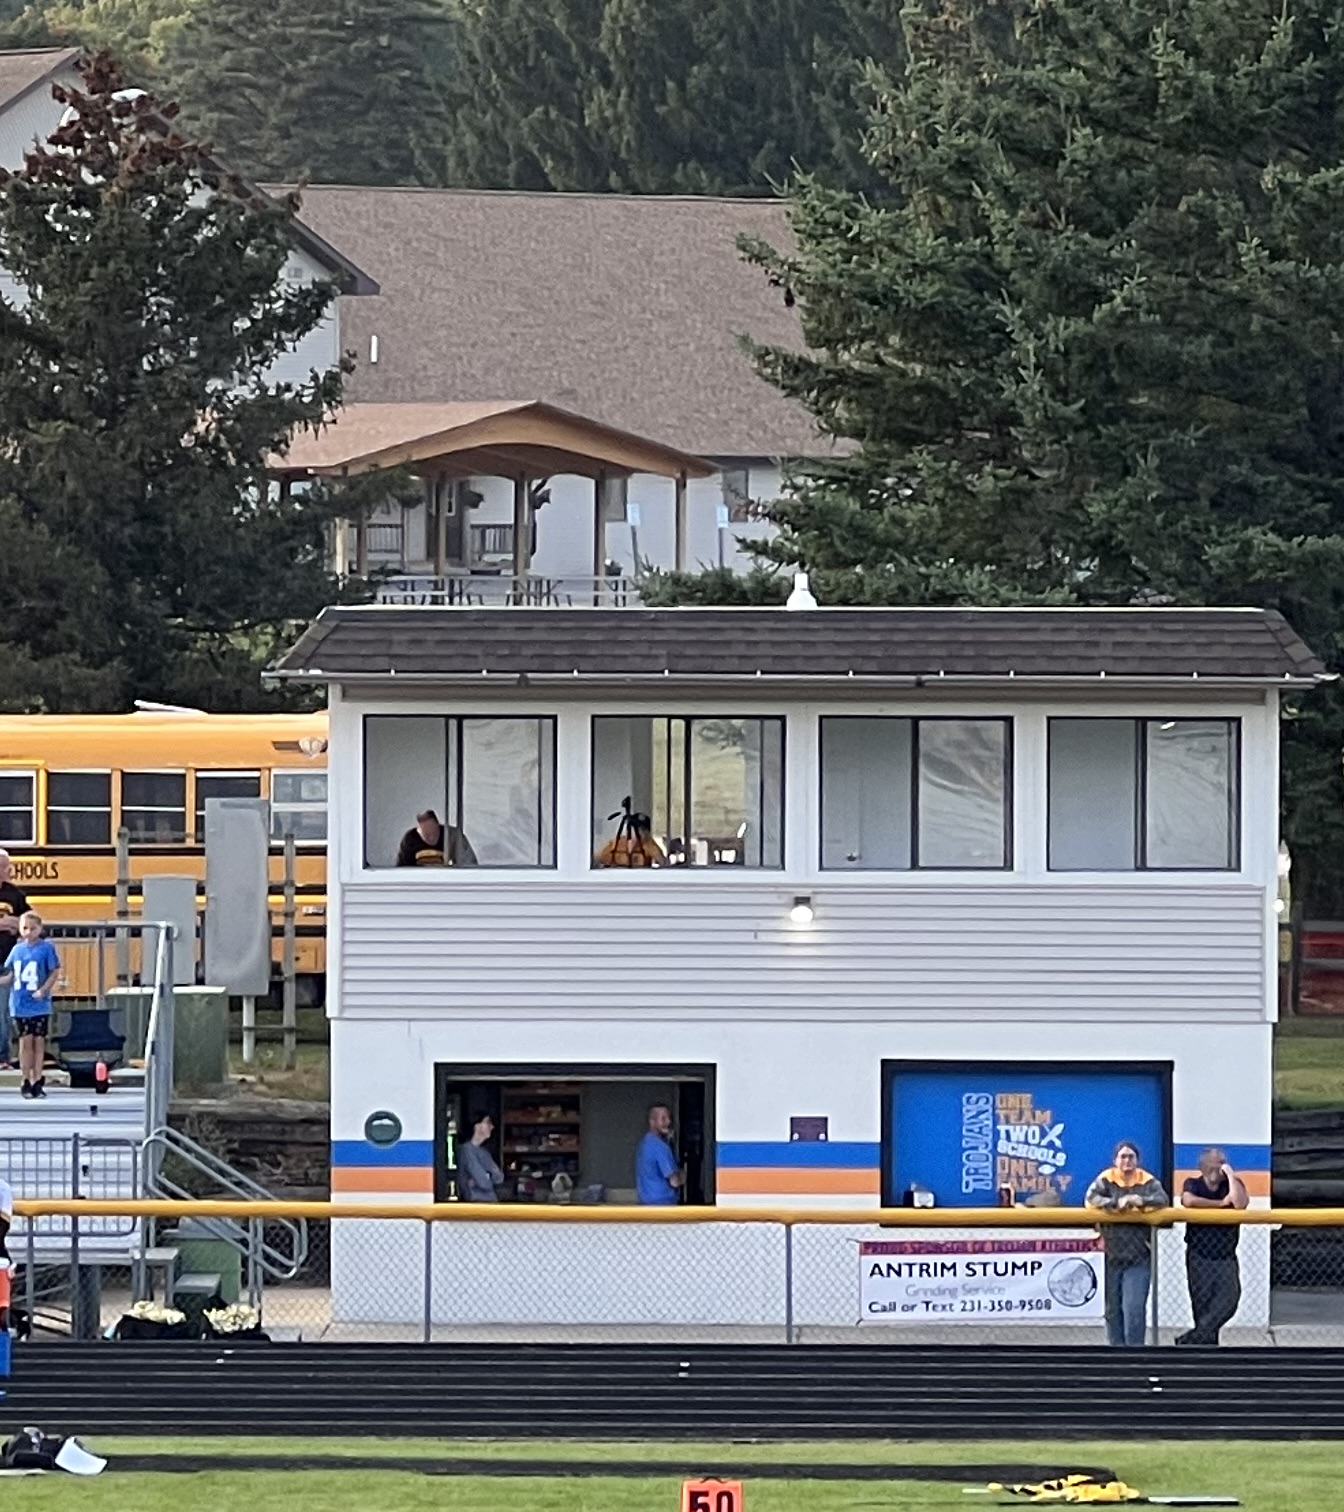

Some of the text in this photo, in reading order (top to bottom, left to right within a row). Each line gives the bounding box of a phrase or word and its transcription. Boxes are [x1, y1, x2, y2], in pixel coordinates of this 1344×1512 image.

[7, 861, 59, 880] CHOOLS
[13, 960, 39, 991] 14
[996, 1109, 1053, 1125] TEAM
[962, 1092, 993, 1194] TROJANS
[997, 1125, 1041, 1145] TWO
[997, 1139, 1067, 1167] SCHOOLS
[996, 1155, 1040, 1177] ONE
[869, 1260, 1043, 1278] ANTRIM STUMP
[905, 1283, 1006, 1300] Grinding Service
[868, 1301, 897, 1314] Call
[901, 1303, 918, 1313] or
[921, 1300, 955, 1314] Text
